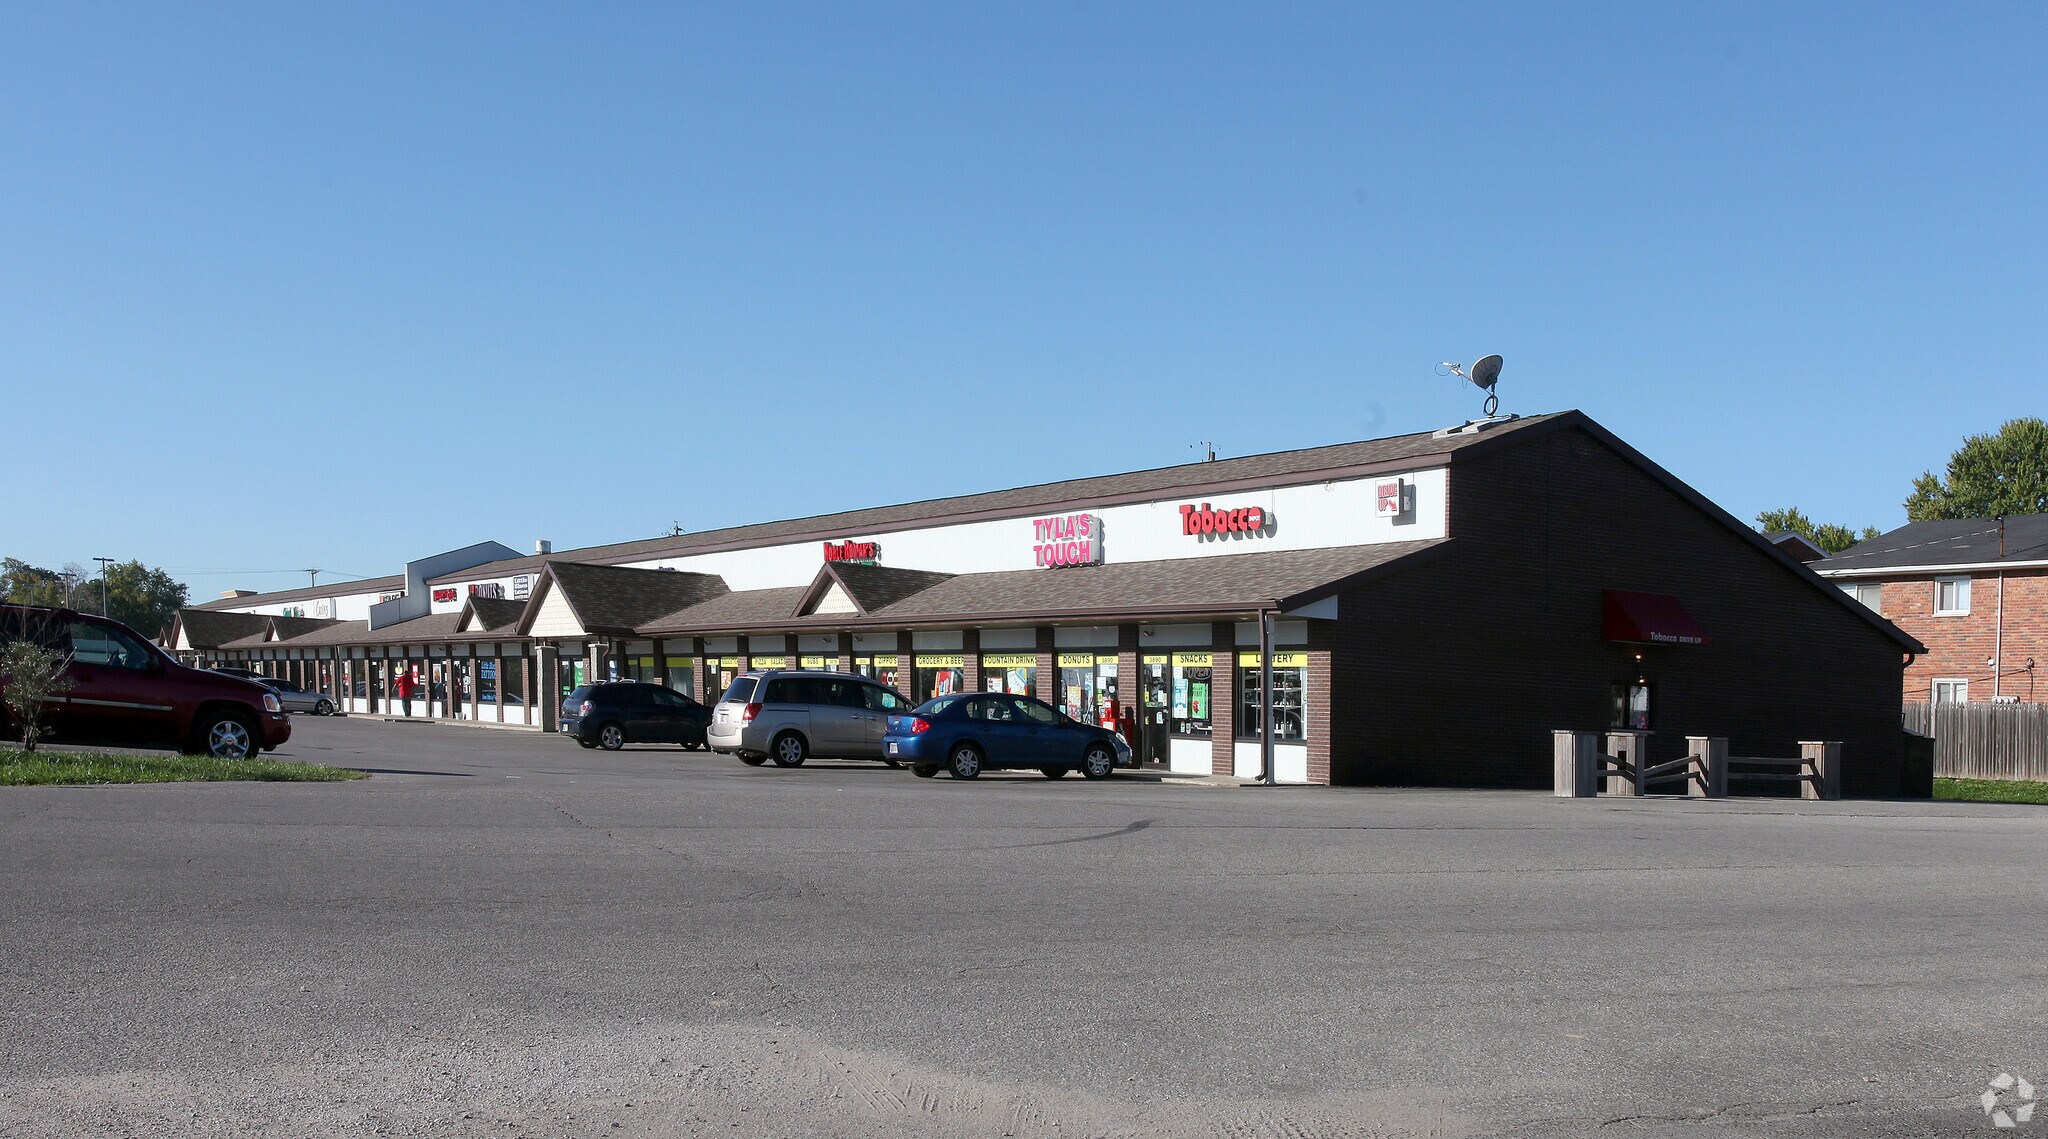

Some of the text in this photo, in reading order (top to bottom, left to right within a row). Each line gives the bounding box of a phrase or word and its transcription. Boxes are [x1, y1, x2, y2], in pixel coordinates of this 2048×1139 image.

[1378, 484, 1397, 498] DRIVE
[1379, 499, 1388, 511] UP
[1179, 503, 1262, 535] Tobacco
[1033, 513, 1090, 540] TYLA'S
[1033, 541, 1090, 566] TOUCH
[1650, 632, 1677, 642] Tobacco
[807, 656, 819, 664] SUBS
[918, 656, 944, 665] GROCERY
[945, 656, 949, 665] &
[985, 656, 1014, 664] FOUNTAIN
[1063, 655, 1090, 664] DONUTS
[1180, 654, 1208, 663] SNACKS
[1256, 654, 1294, 663] LTERY
